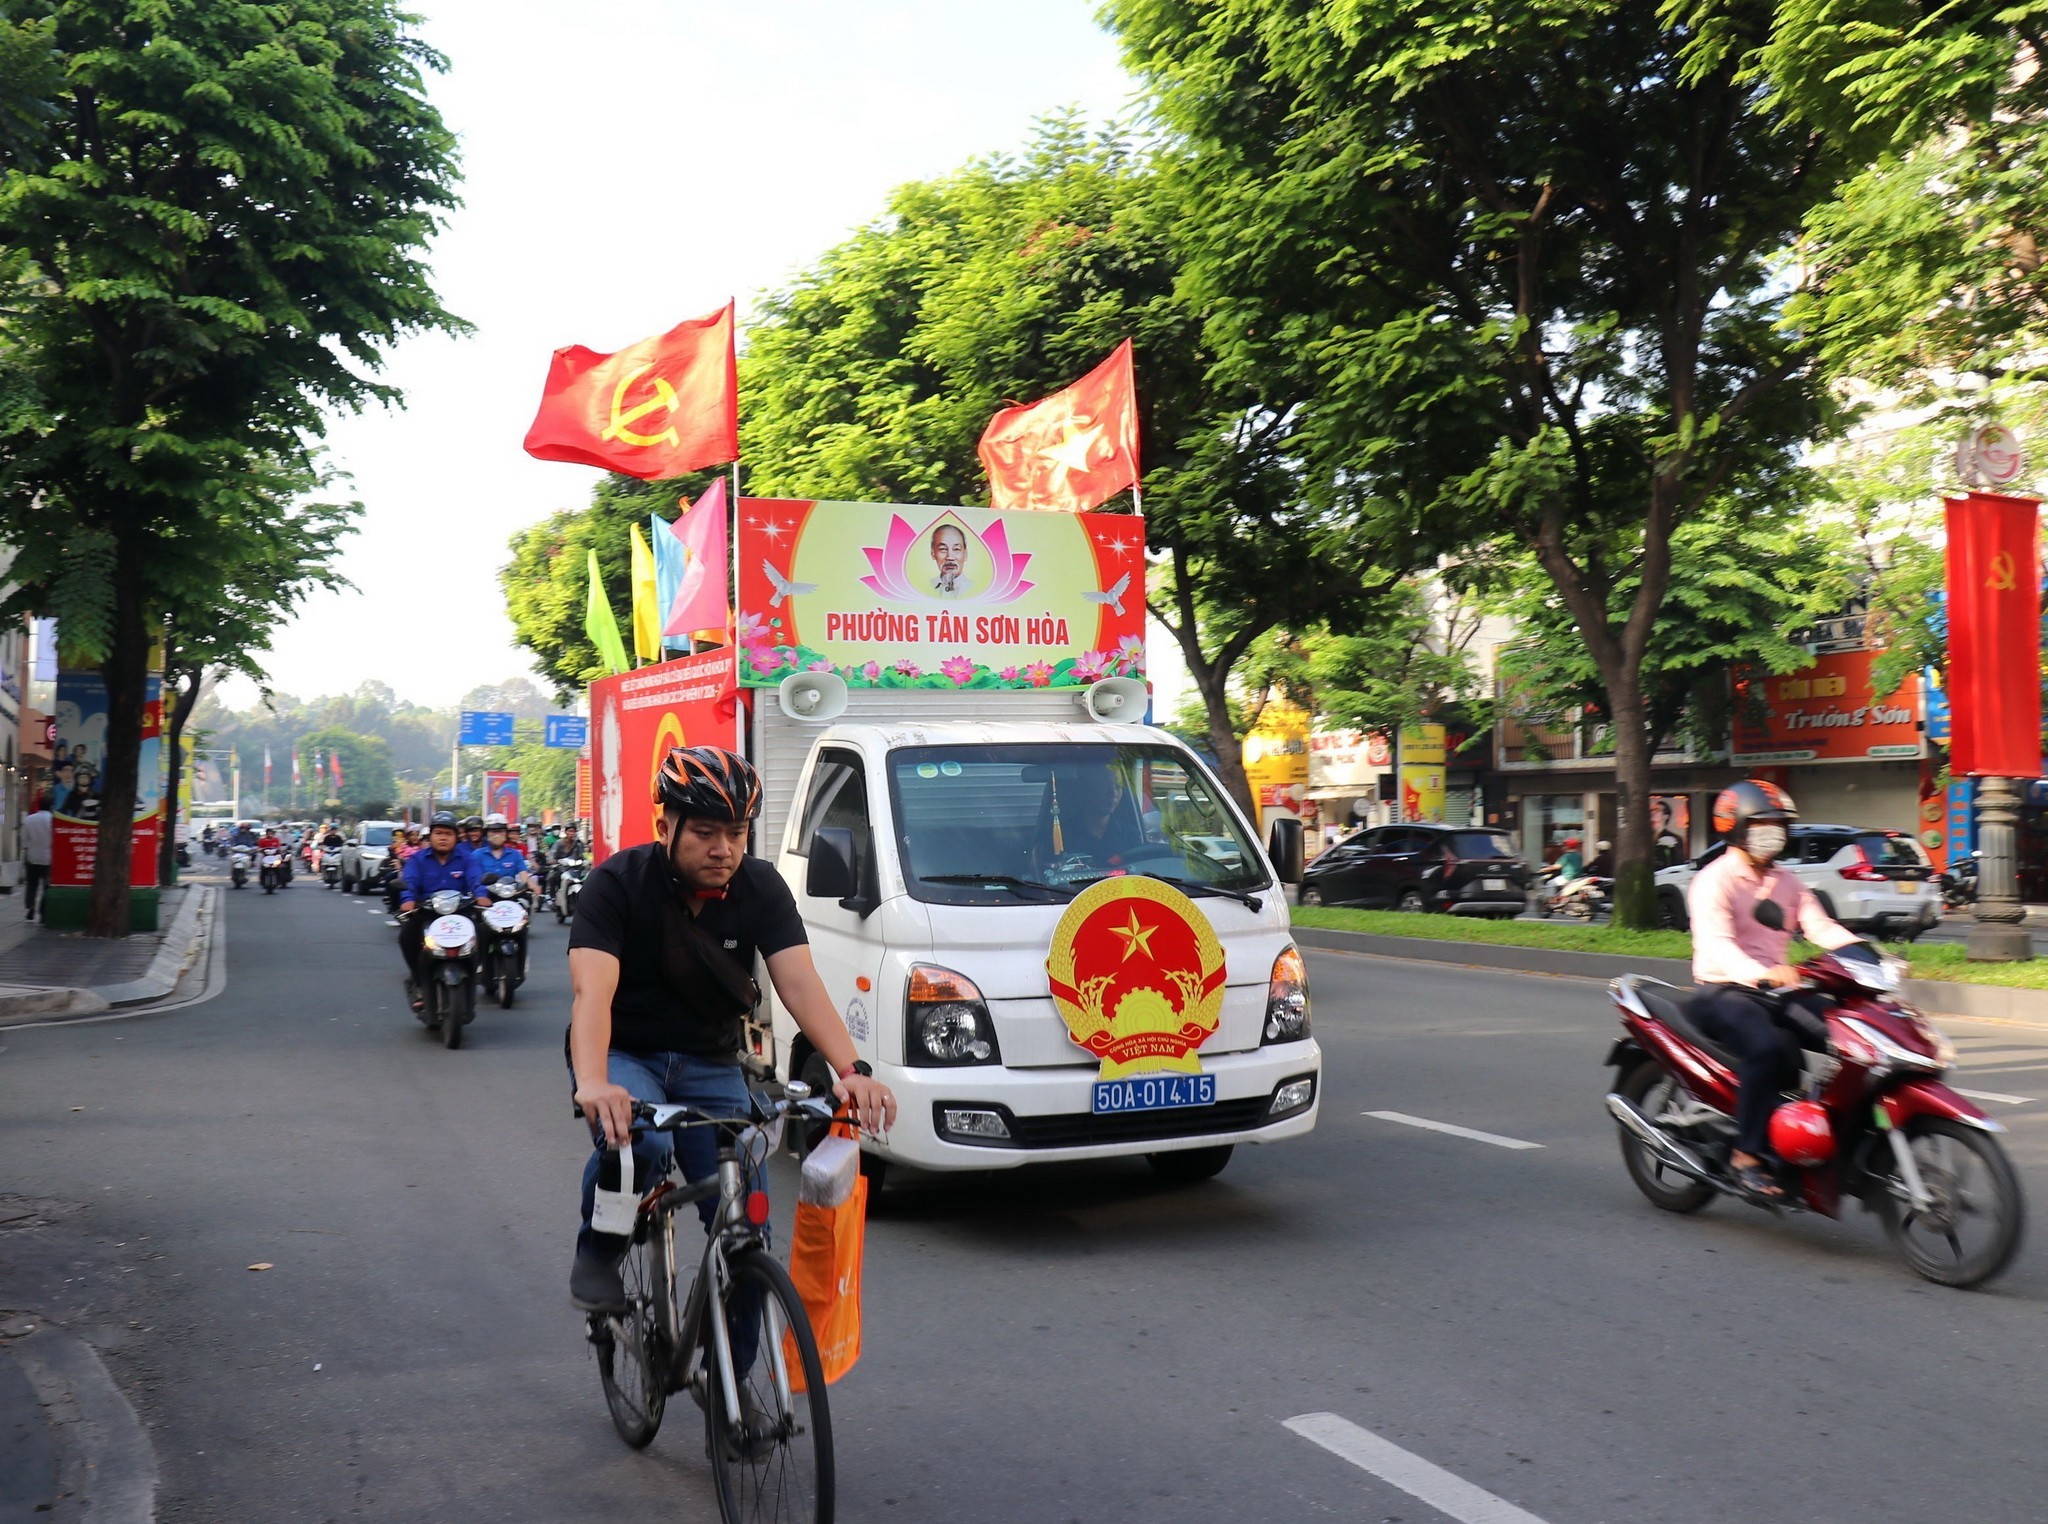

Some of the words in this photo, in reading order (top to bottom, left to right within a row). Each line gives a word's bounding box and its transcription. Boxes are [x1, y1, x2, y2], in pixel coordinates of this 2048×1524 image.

[827, 607, 919, 642] PHƯỜNG
[926, 609, 969, 643] TÂN
[975, 614, 1020, 644] SƠN
[1026, 611, 1070, 645] HÒA
[1870, 704, 1911, 726] Sơn
[1122, 1043, 1148, 1058] VIỆT
[1150, 1043, 1175, 1054] NAM
[1097, 1076, 1211, 1110] 50A-014.15
